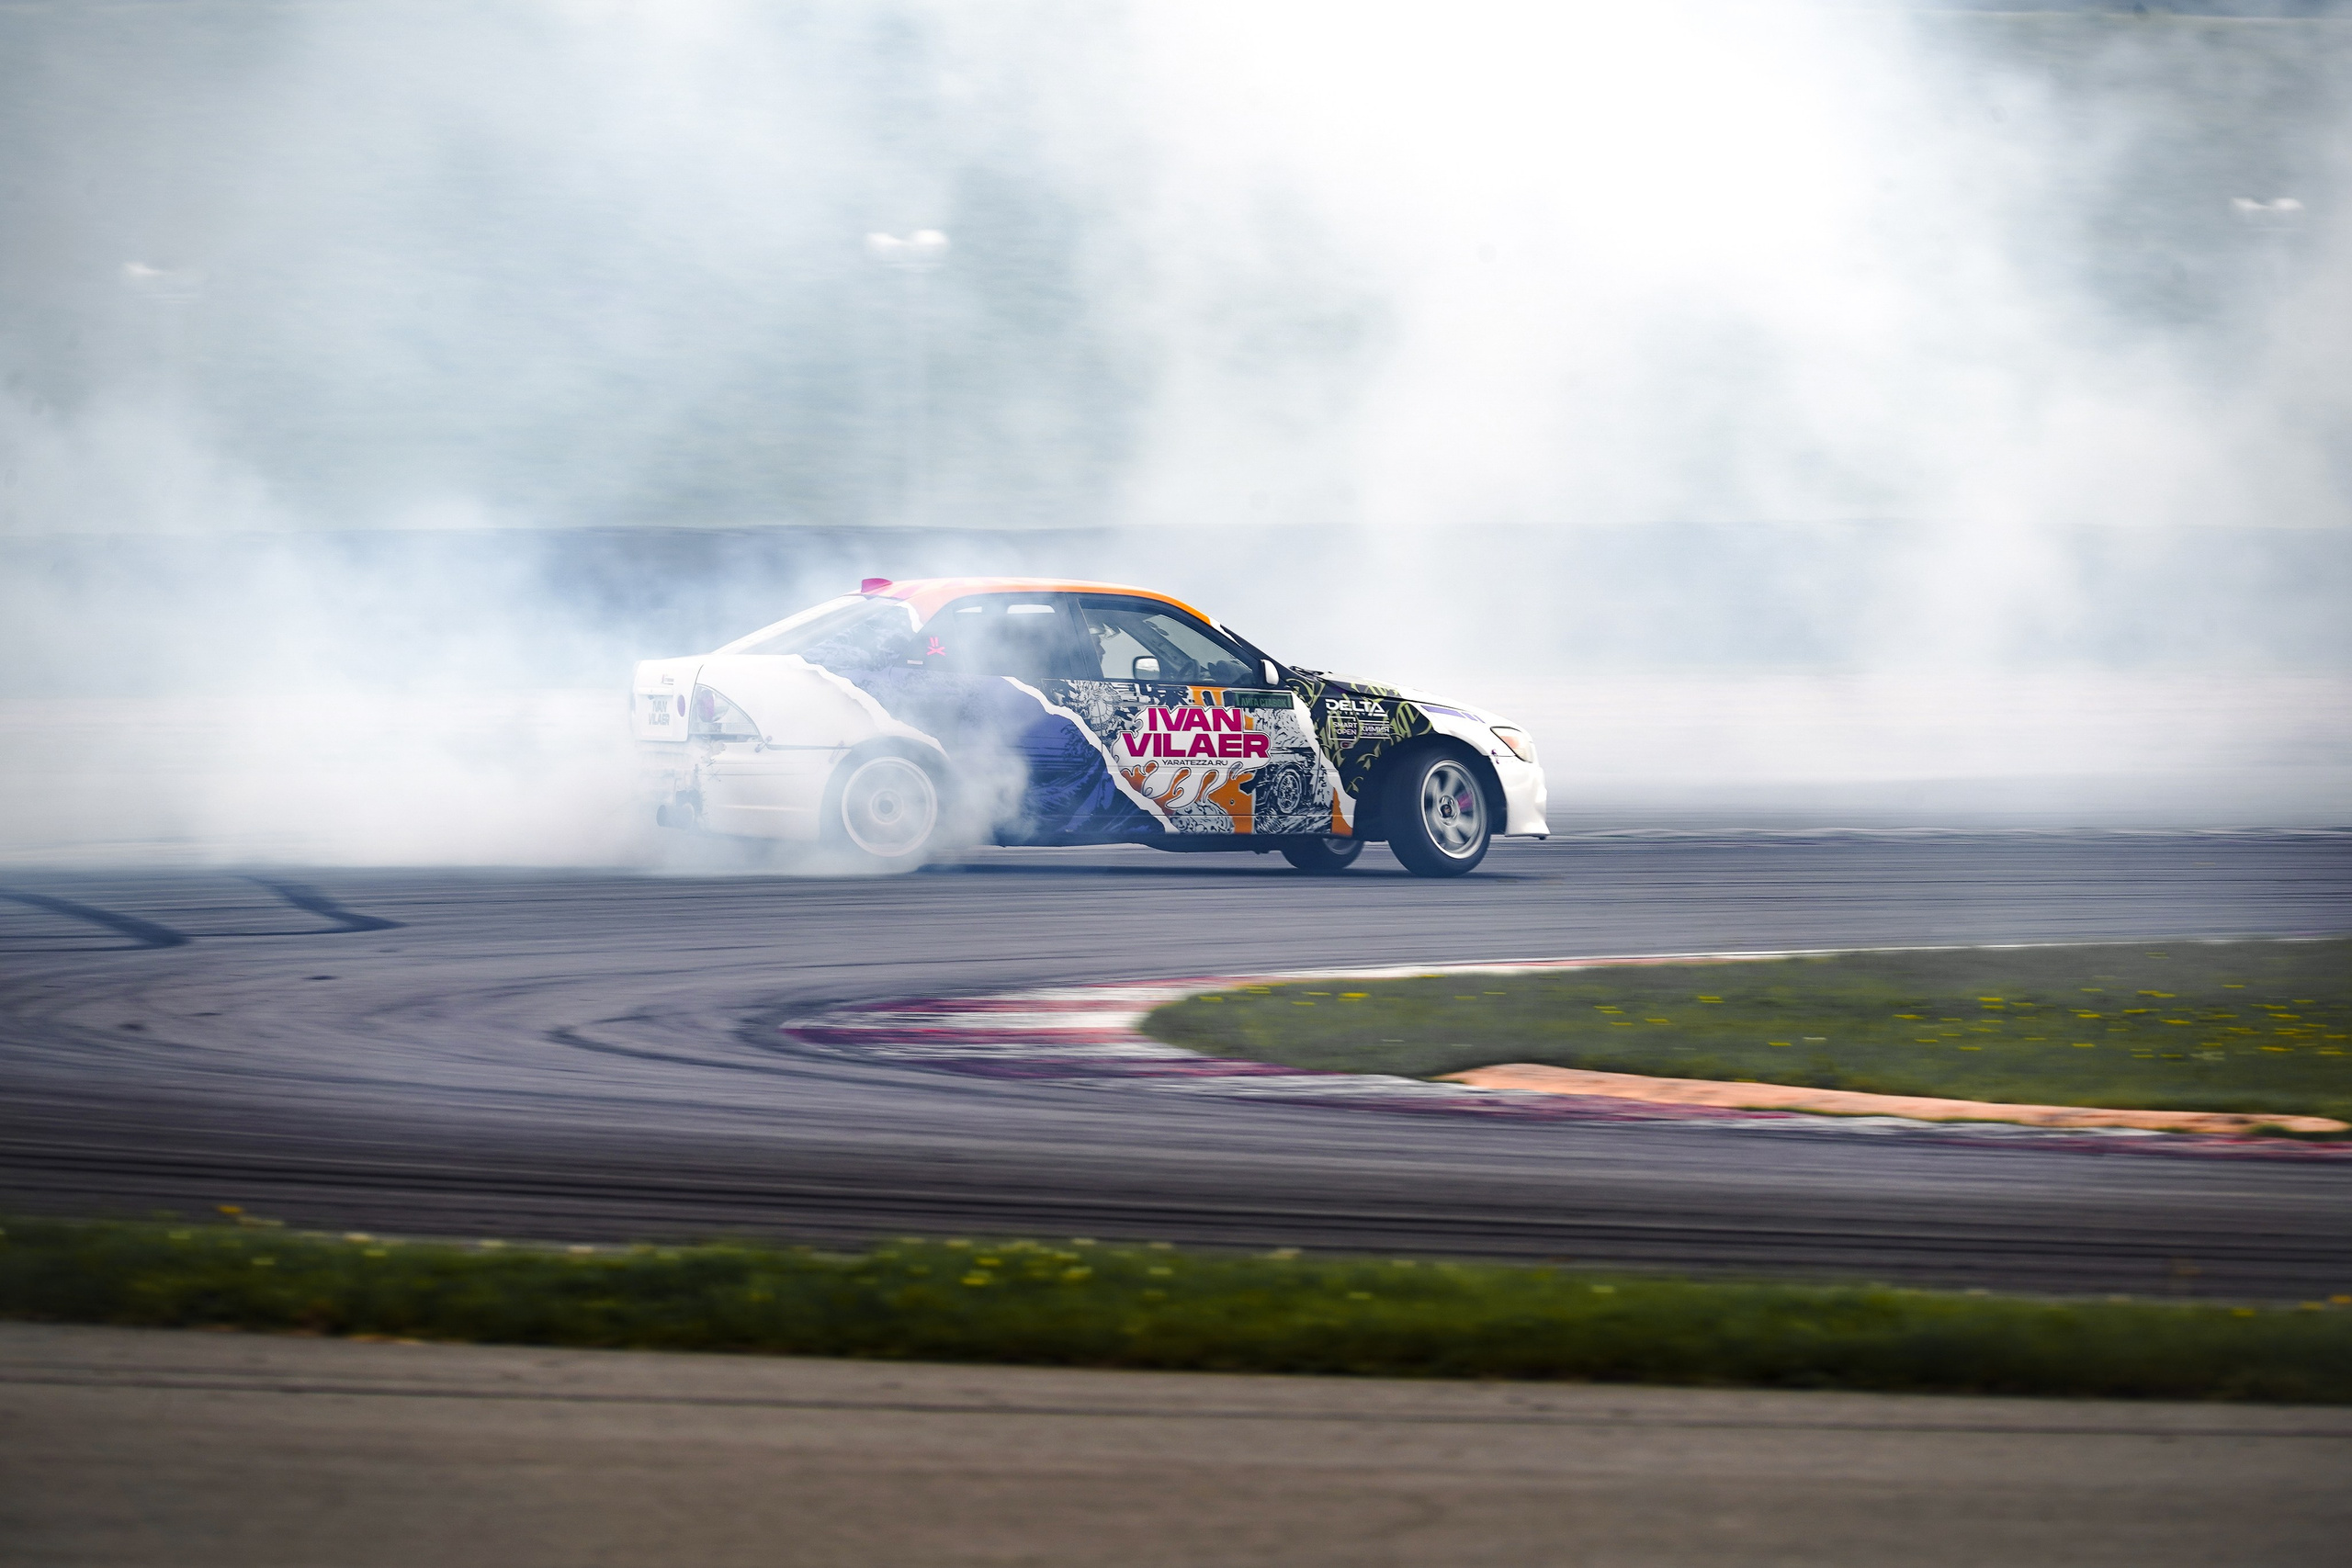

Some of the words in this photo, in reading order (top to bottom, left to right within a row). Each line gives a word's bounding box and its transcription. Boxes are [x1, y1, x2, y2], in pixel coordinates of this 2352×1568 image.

[1325, 699, 1388, 716] DELTA
[1148, 708, 1241, 731] IVAN
[1123, 733, 1270, 758] VILAER
